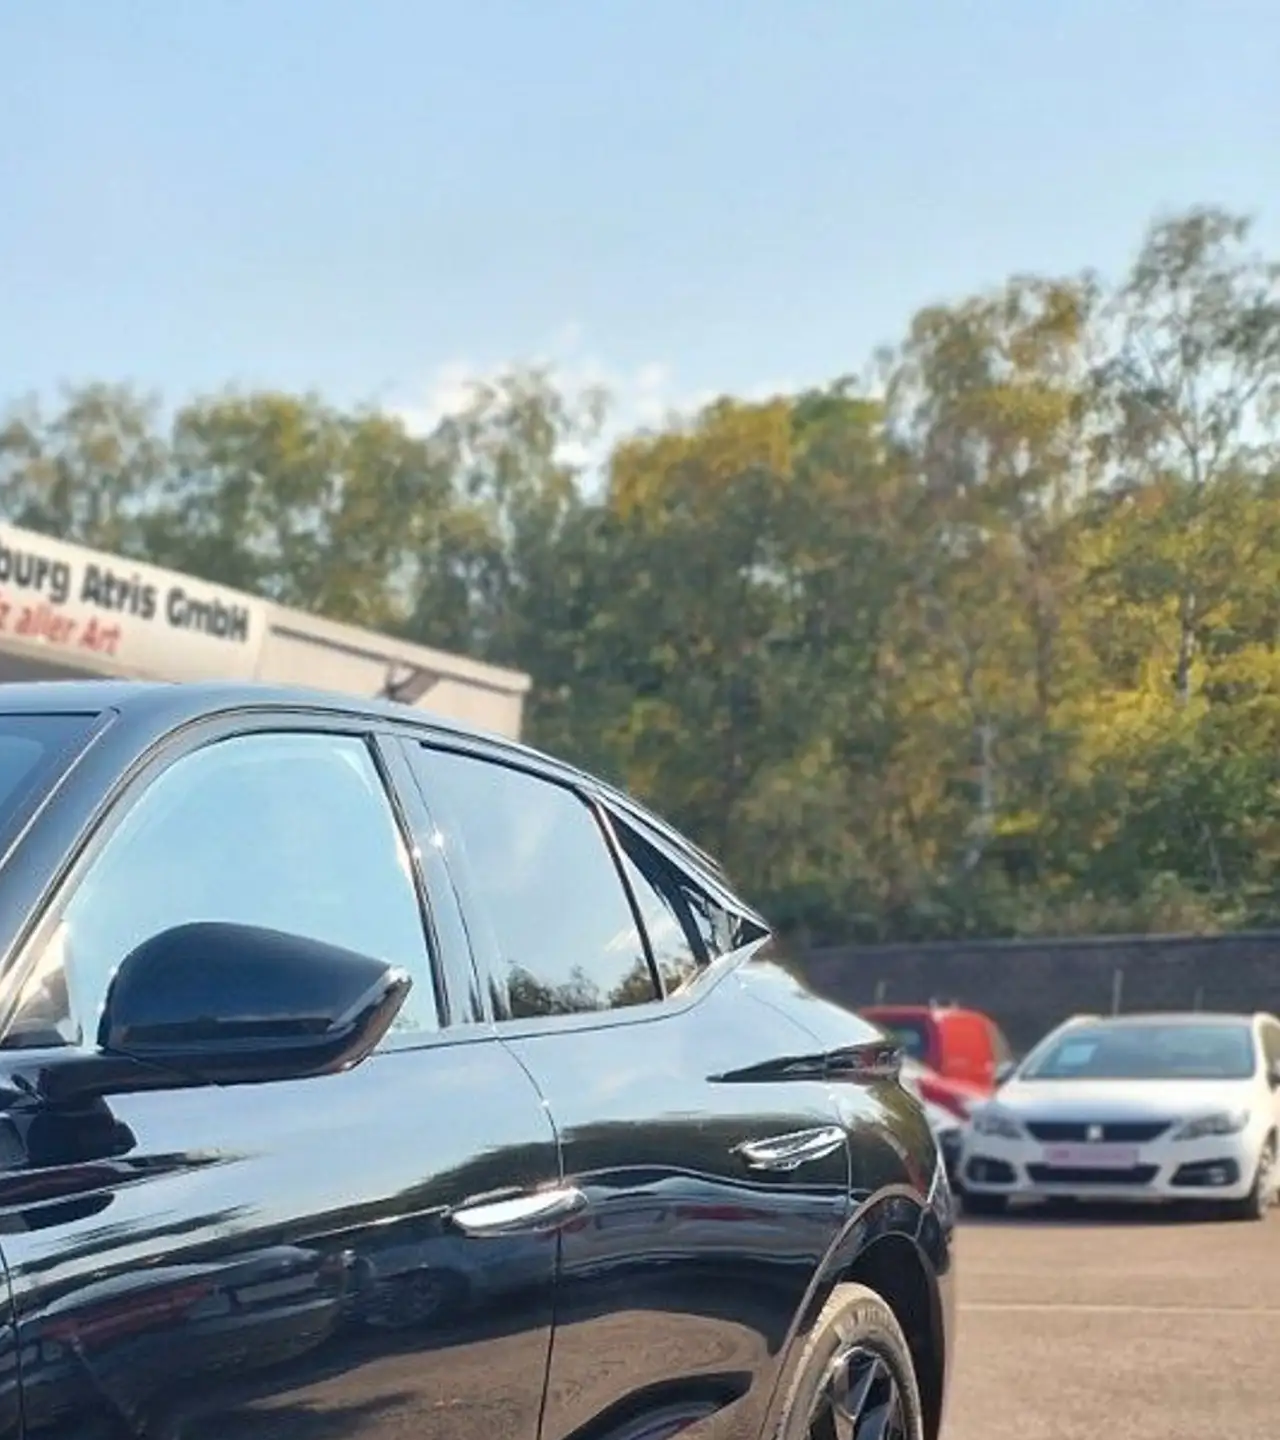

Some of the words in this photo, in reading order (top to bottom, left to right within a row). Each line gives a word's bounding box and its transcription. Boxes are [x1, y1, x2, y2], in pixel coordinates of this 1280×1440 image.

[15, 602, 77, 642] aller
[79, 615, 122, 656] Art
[80, 563, 157, 620] Atris
[166, 586, 249, 643] GmbH
